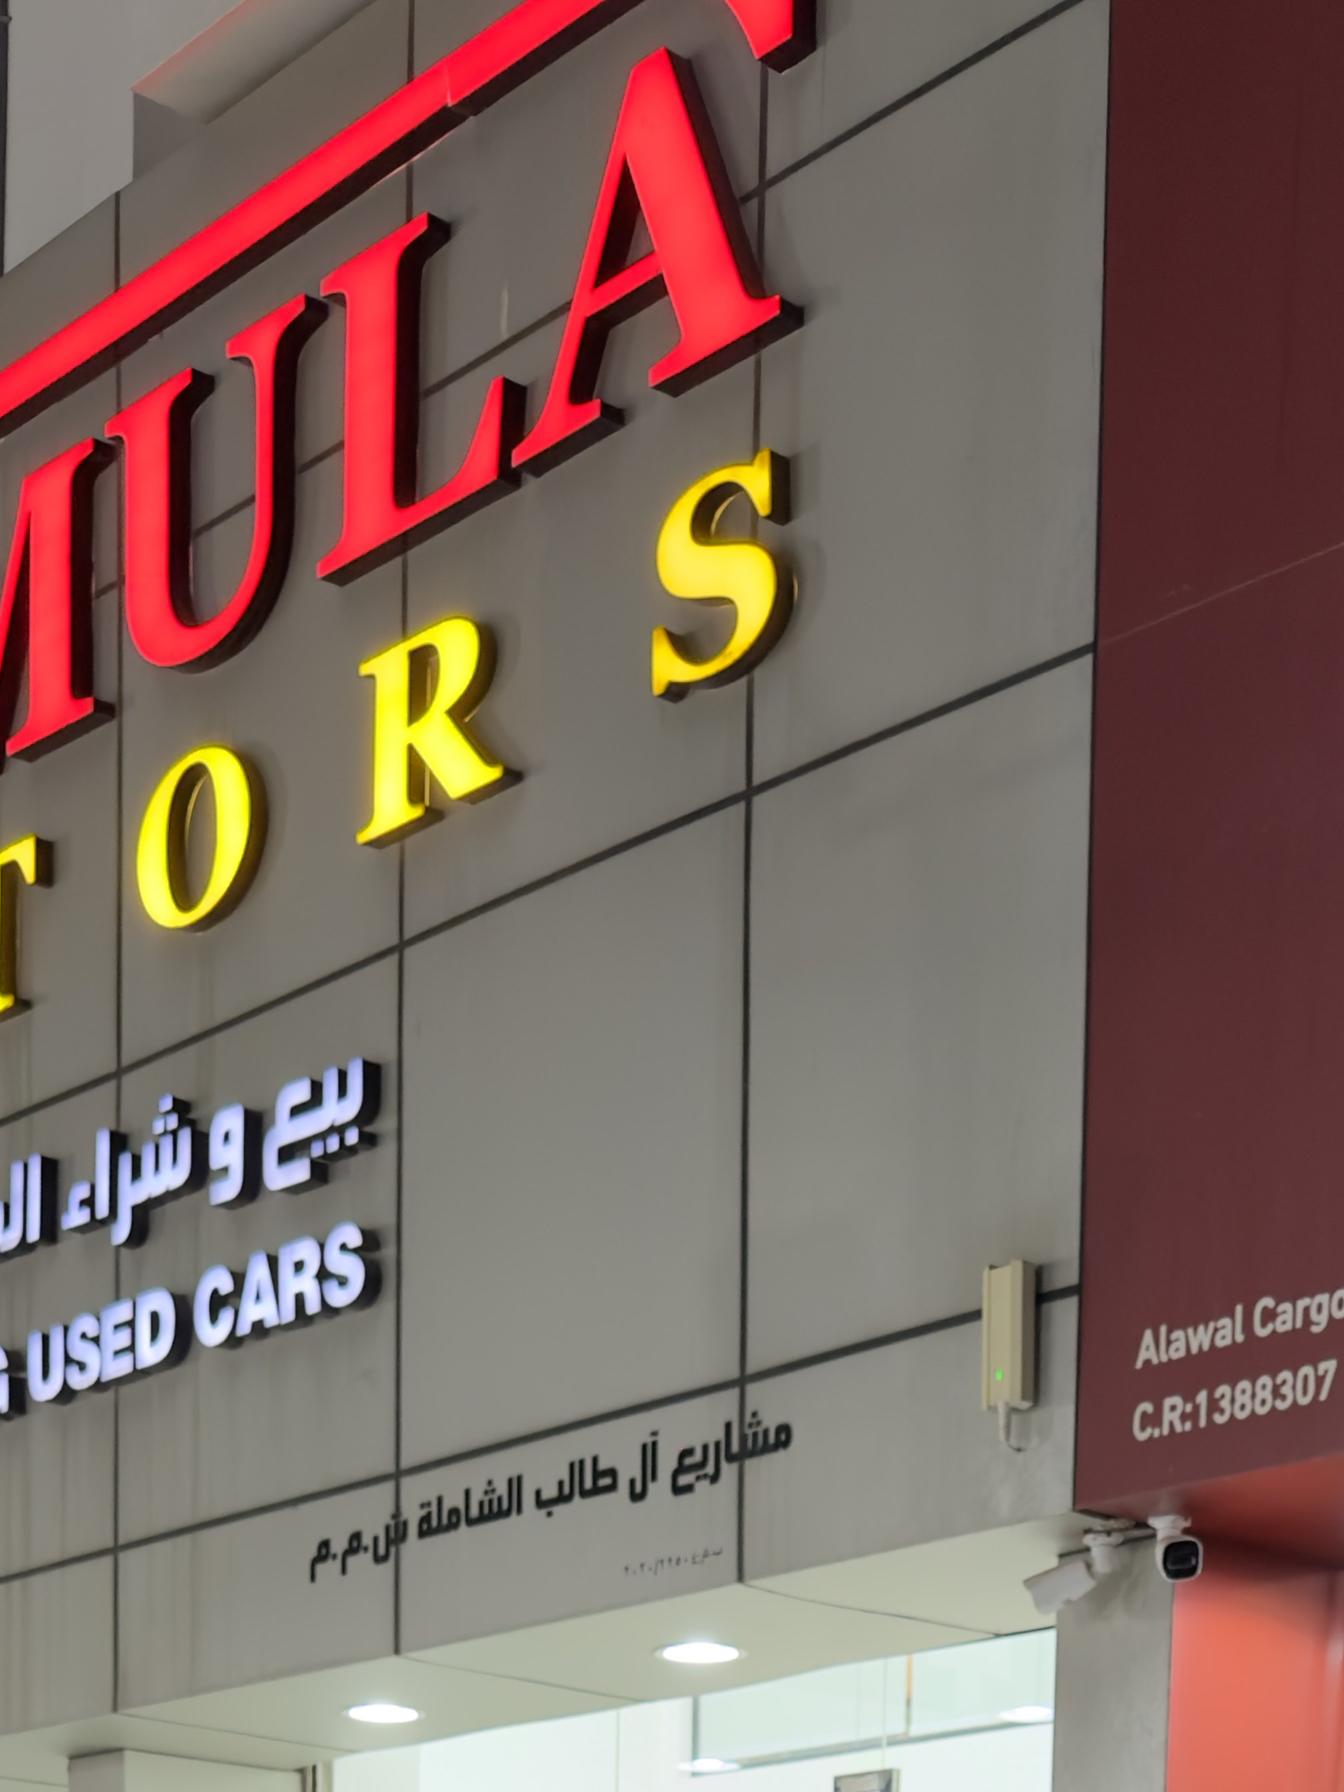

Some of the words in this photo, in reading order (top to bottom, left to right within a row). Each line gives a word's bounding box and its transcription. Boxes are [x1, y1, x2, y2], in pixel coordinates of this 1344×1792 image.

[209, 1103, 245, 1206] و
[262, 1056, 364, 1192] بيع
[61, 1093, 192, 1246] شراء
[27, 1287, 176, 1402] USED
[193, 1220, 366, 1347] CARS
[1135, 1304, 1244, 1370] Alawal
[1132, 1359, 1338, 1442] C.R:1388307
[535, 1455, 618, 1518] طالب
[670, 1410, 794, 1496] مشاريع
[416, 1473, 524, 1540] الشاملة
